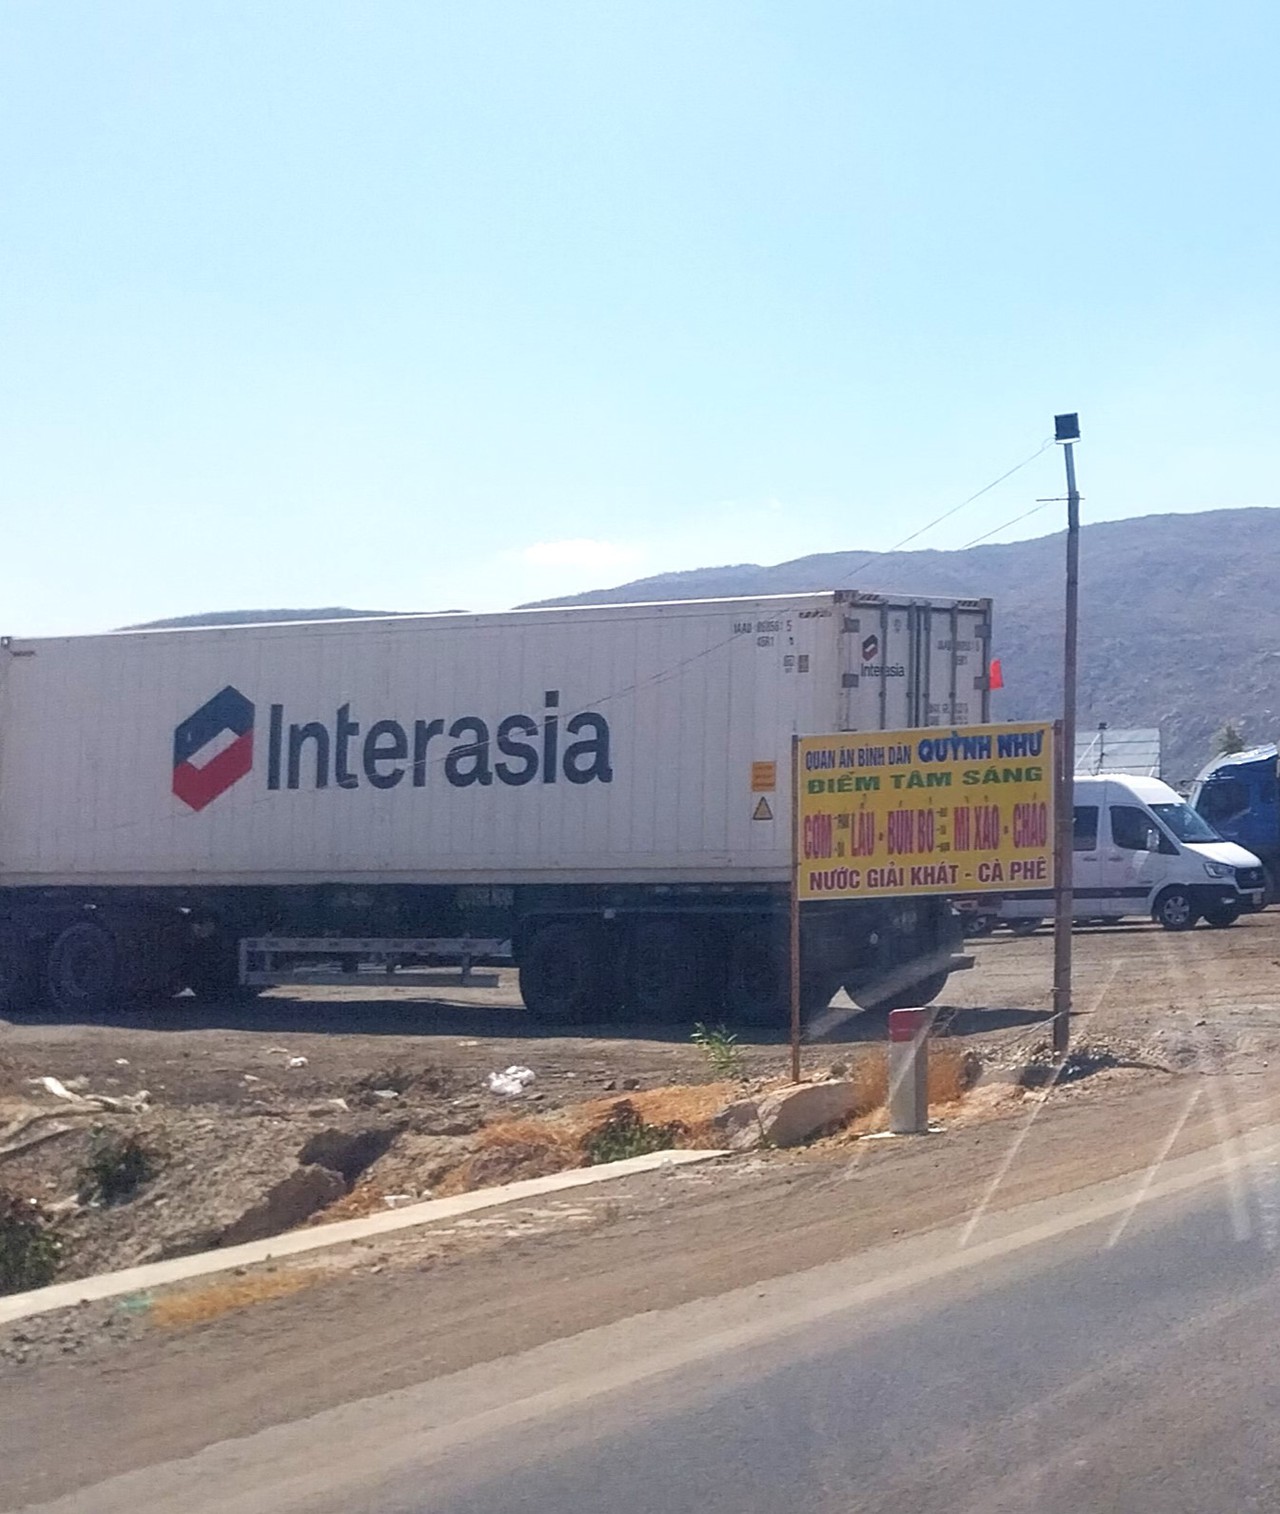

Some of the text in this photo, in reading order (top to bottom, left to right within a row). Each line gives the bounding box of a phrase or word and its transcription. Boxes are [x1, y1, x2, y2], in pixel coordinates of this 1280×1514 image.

[860, 663, 905, 677] Inteasia
[267, 690, 613, 790] Interasia
[805, 746, 836, 771] QUÁN
[918, 731, 992, 762] QUỲNH
[997, 729, 1044, 759] NHƯ
[807, 766, 1042, 794] ĐIỂM TÂM SÁNG
[809, 867, 860, 891] NƯỚC
[867, 861, 905, 888] GIẢI
[911, 861, 959, 886] KHÁT
[978, 859, 1004, 883] CÀ
[1009, 856, 1046, 880] PHÊ
